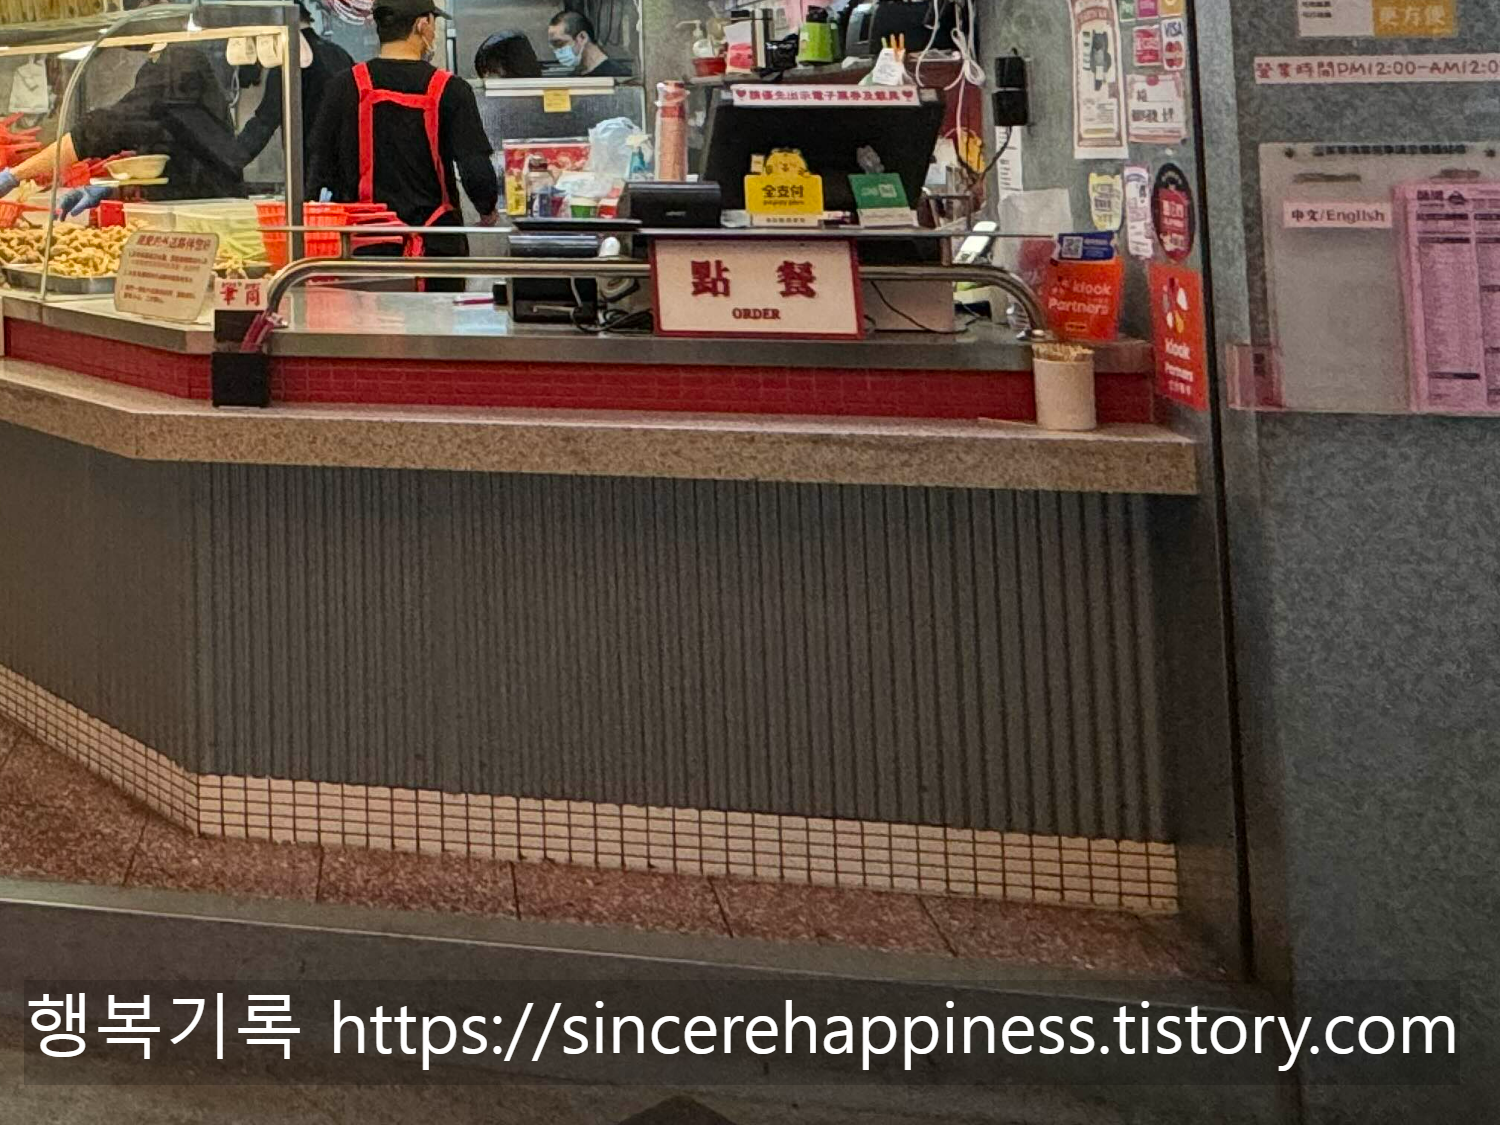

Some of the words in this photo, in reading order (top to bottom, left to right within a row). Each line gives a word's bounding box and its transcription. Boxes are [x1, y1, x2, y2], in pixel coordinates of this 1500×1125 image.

[1165, 22, 1183, 37] VISA
[763, 184, 804, 199] 全支付
[1291, 208, 1386, 224] 中文/English
[691, 260, 818, 299] 點餐
[1047, 297, 1109, 316] Partners
[732, 308, 781, 321] ORDER
